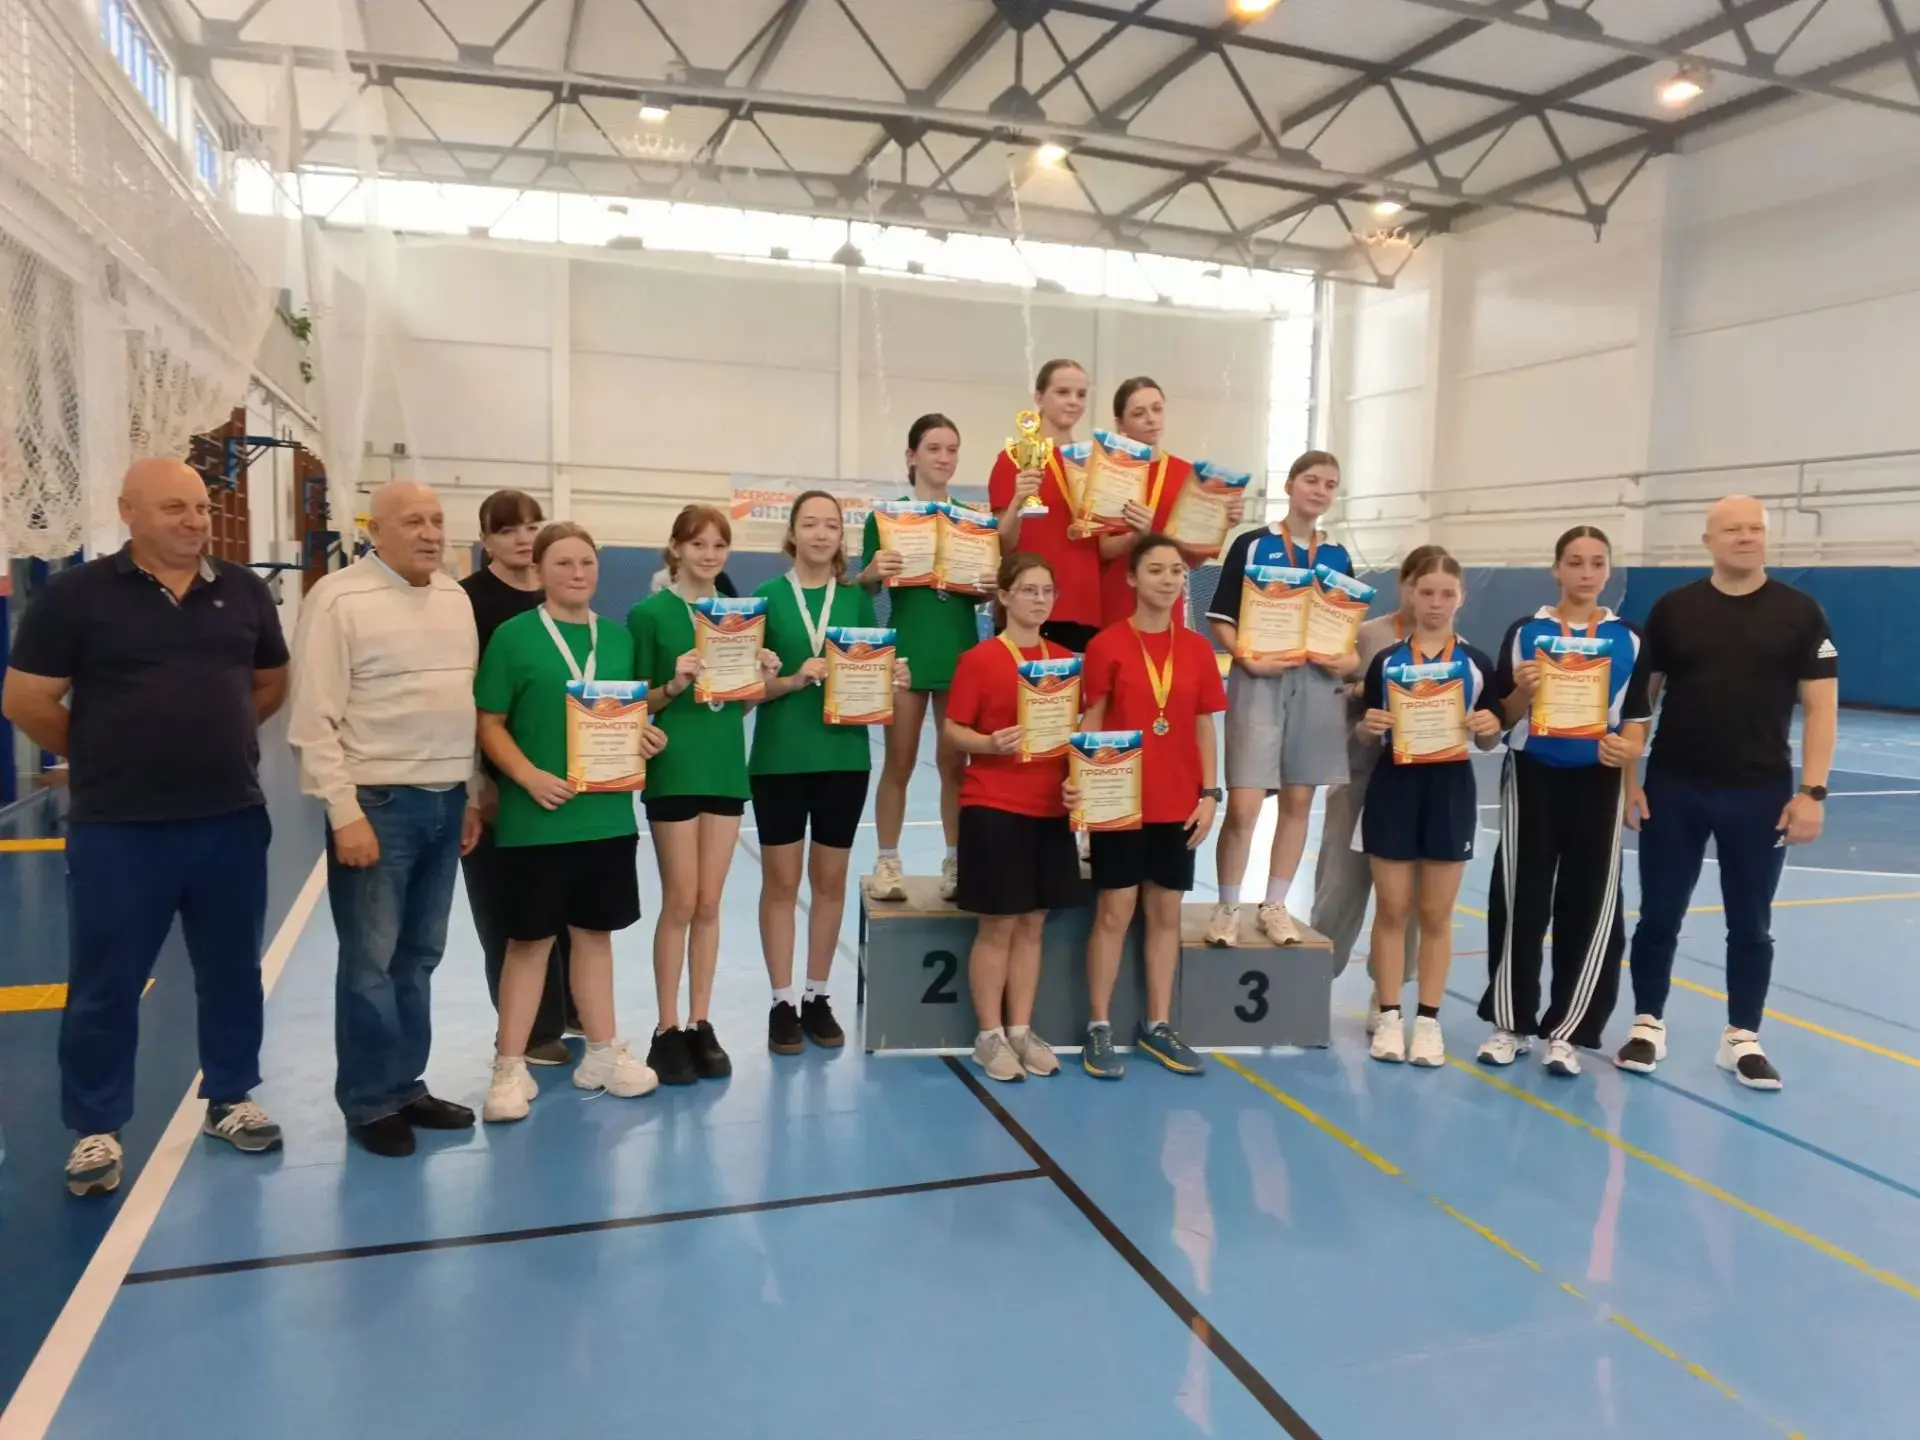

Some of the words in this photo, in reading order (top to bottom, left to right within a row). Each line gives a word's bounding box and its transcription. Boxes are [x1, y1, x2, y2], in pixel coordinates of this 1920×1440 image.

[1250, 600, 1303, 611] ГРАМОТА
[1310, 599, 1355, 624] ГРАМОТА
[705, 634, 757, 645] ГРАМОТА
[834, 663, 888, 672] ГРАМОТА
[1545, 672, 1602, 682] ГРАМОТА
[1026, 694, 1074, 706] ГРАМОТА
[1400, 699, 1456, 710] ГРАМОТА
[578, 721, 639, 731] ГРАМОТА
[1080, 766, 1134, 777] ГРАМОТА
[922, 950, 958, 1004] 2
[1234, 970, 1270, 1024] 3
